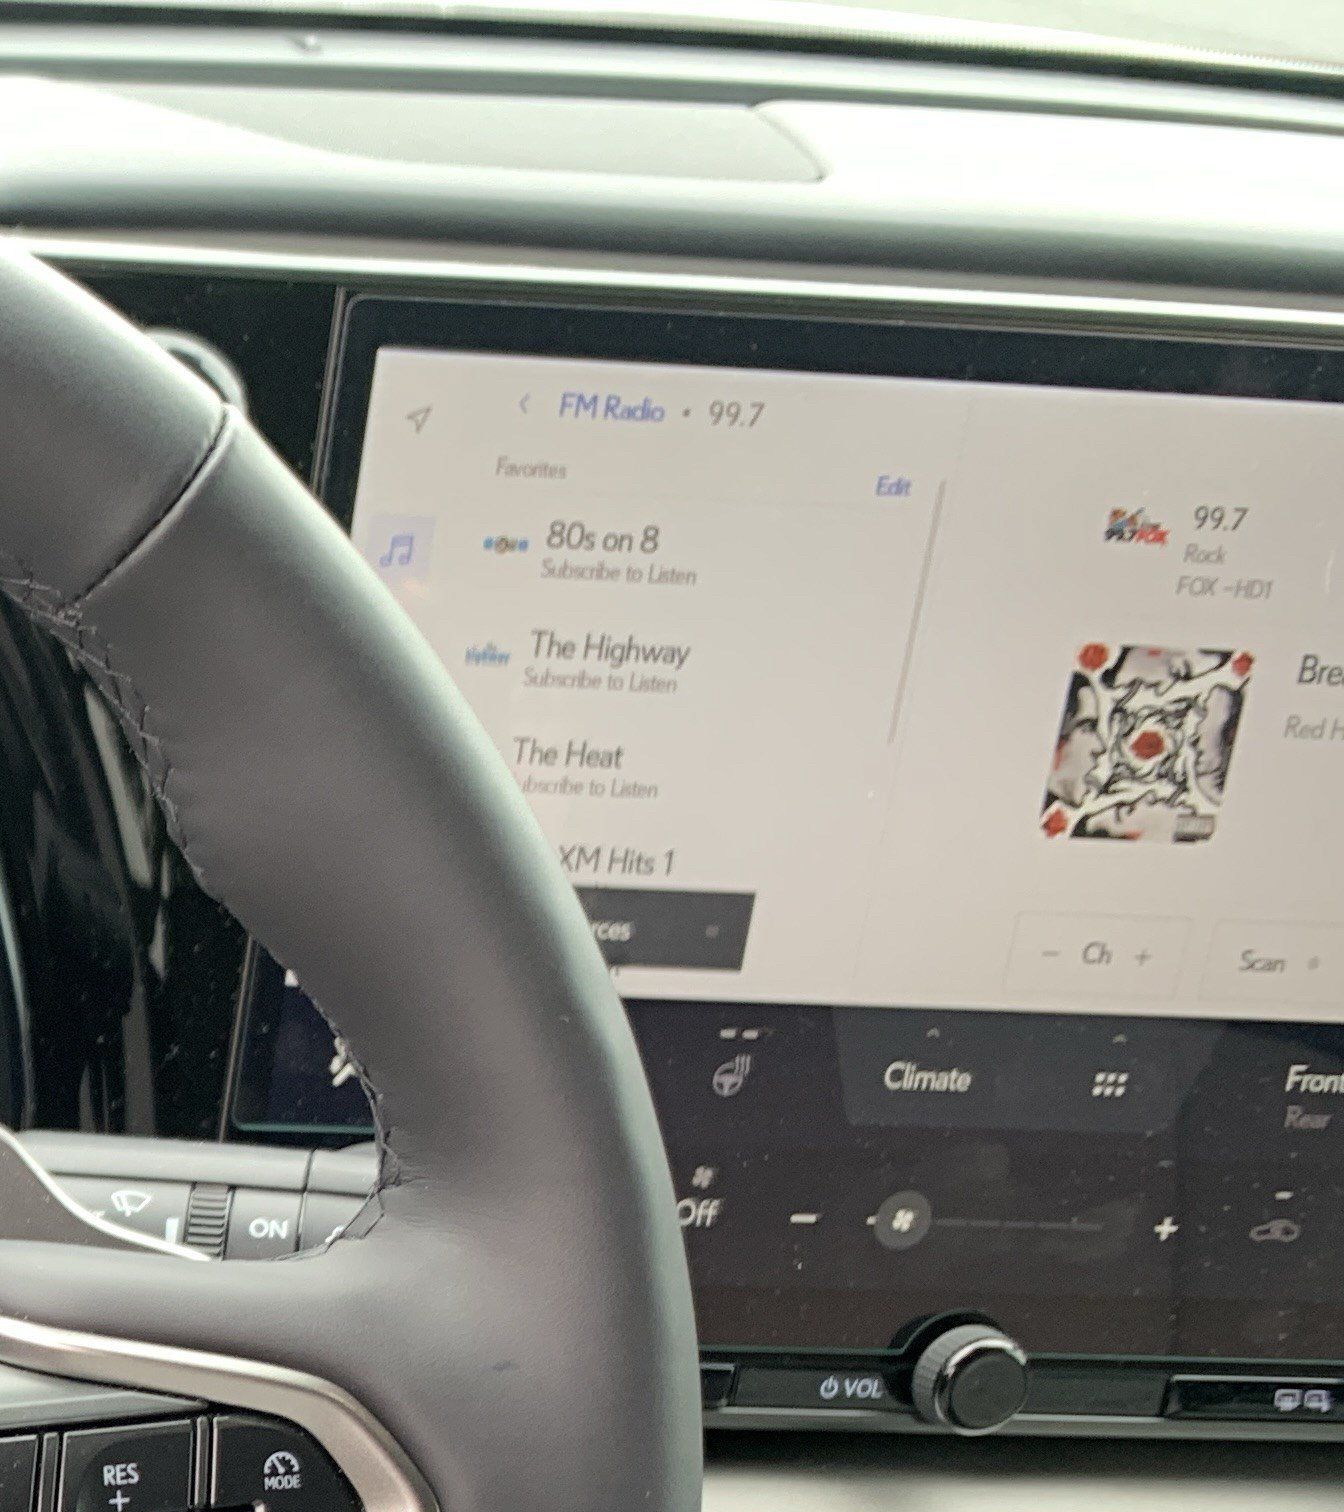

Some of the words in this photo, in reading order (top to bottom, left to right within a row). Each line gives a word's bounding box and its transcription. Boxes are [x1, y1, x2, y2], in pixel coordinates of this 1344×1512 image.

[559, 392, 598, 419] FM
[604, 394, 665, 422] Radio
[709, 400, 765, 428] 99.7
[495, 456, 567, 480] Favorites
[875, 474, 911, 496] Edit
[1193, 505, 1249, 532] 99.7
[546, 519, 595, 552] 80s
[602, 533, 633, 552] on
[640, 525, 660, 554] 8
[1183, 543, 1227, 565] Rock
[540, 557, 621, 582] Subscribe
[626, 568, 643, 584] to
[648, 566, 698, 587] Listen
[1175, 576, 1218, 598] FOX
[531, 629, 576, 660] The
[583, 632, 691, 670] Highway
[524, 667, 602, 691] Subscribe
[607, 675, 624, 692] to
[629, 671, 678, 694] Listen
[1298, 654, 1344, 687] Bre
[1284, 714, 1327, 740] Red
[514, 737, 558, 766] The
[565, 739, 624, 770] Heat
[515, 774, 583, 796] ubscribe
[589, 778, 606, 796] to
[611, 777, 659, 799] Listen
[608, 847, 655, 876] Hits
[665, 849, 675, 878] 1
[1082, 941, 1112, 965] Ch
[1238, 949, 1288, 973] Scan
[884, 1062, 972, 1093] Climate
[1283, 1105, 1332, 1130] Rear
[676, 1199, 723, 1228] Off
[248, 1217, 290, 1240] ON
[844, 1376, 883, 1400] VOL
[102, 1462, 140, 1487] RES
[263, 1474, 302, 1491] MODE
